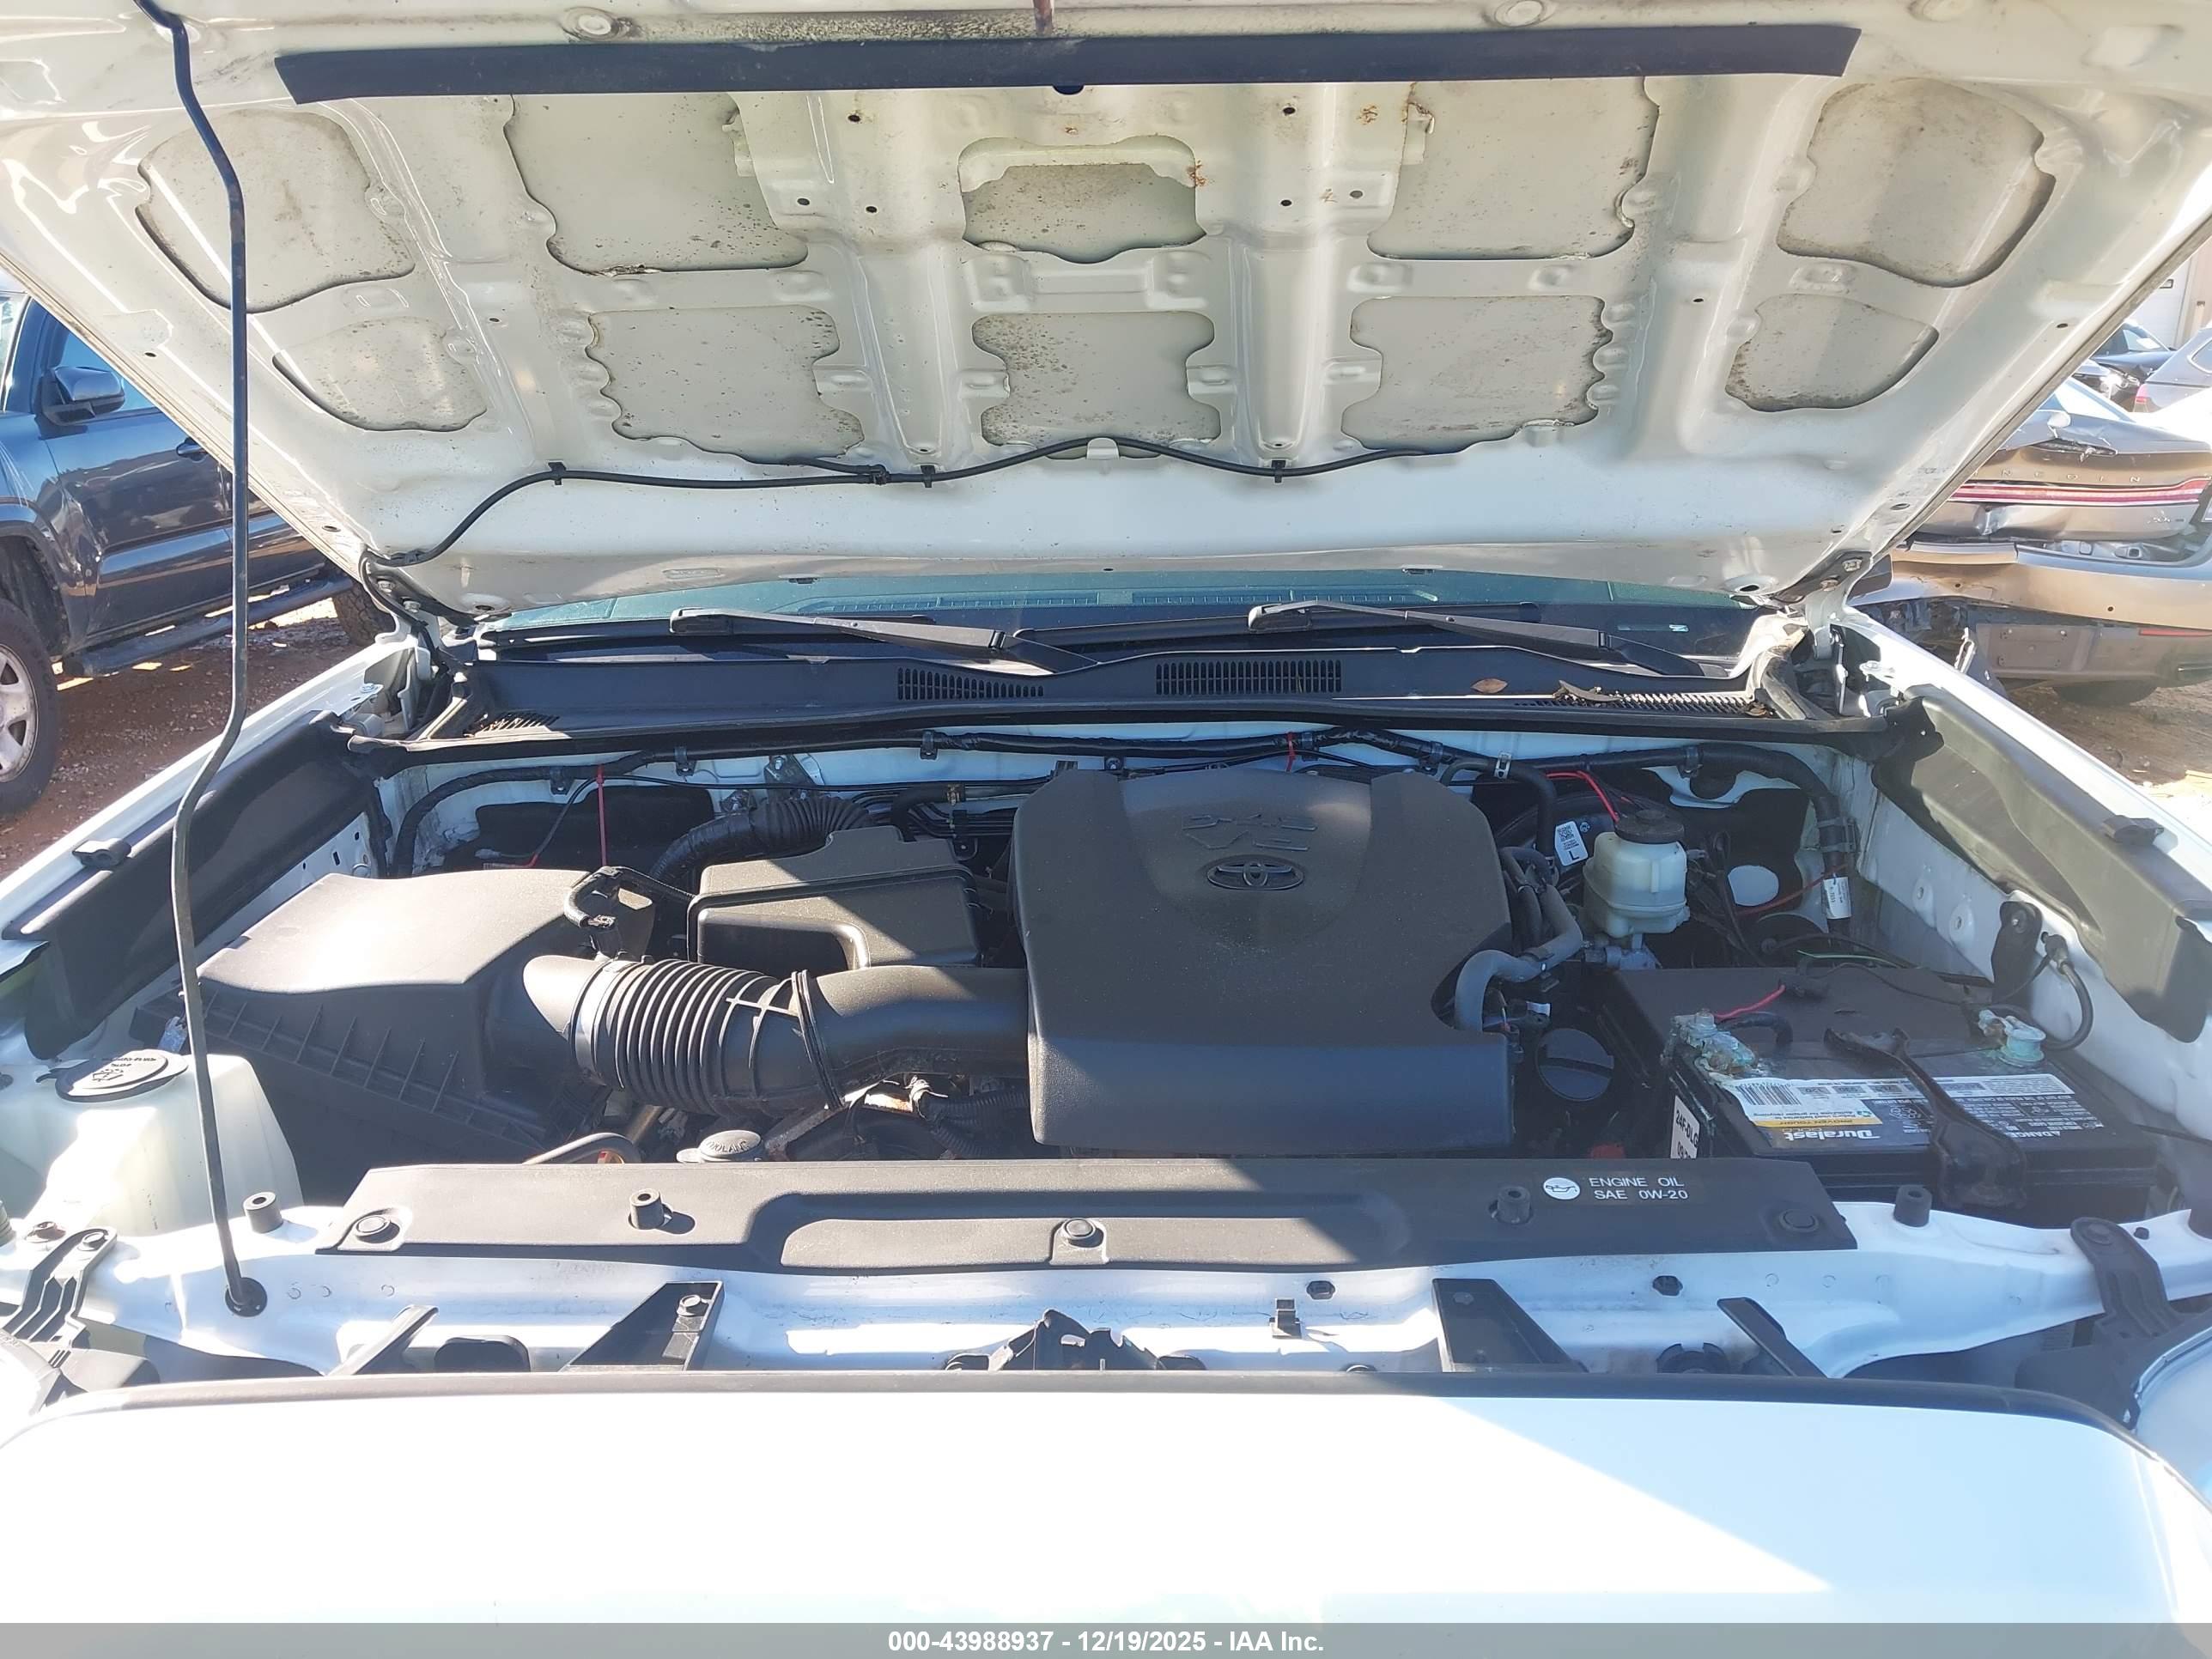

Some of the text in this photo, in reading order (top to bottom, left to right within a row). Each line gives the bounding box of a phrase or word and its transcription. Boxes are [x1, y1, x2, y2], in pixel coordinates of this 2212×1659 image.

[1784, 1129, 1881, 1141] Duralast
[1589, 1177, 1685, 1188] ENGINE OIL
[1594, 1189, 1689, 1200] SAE 0W-20
